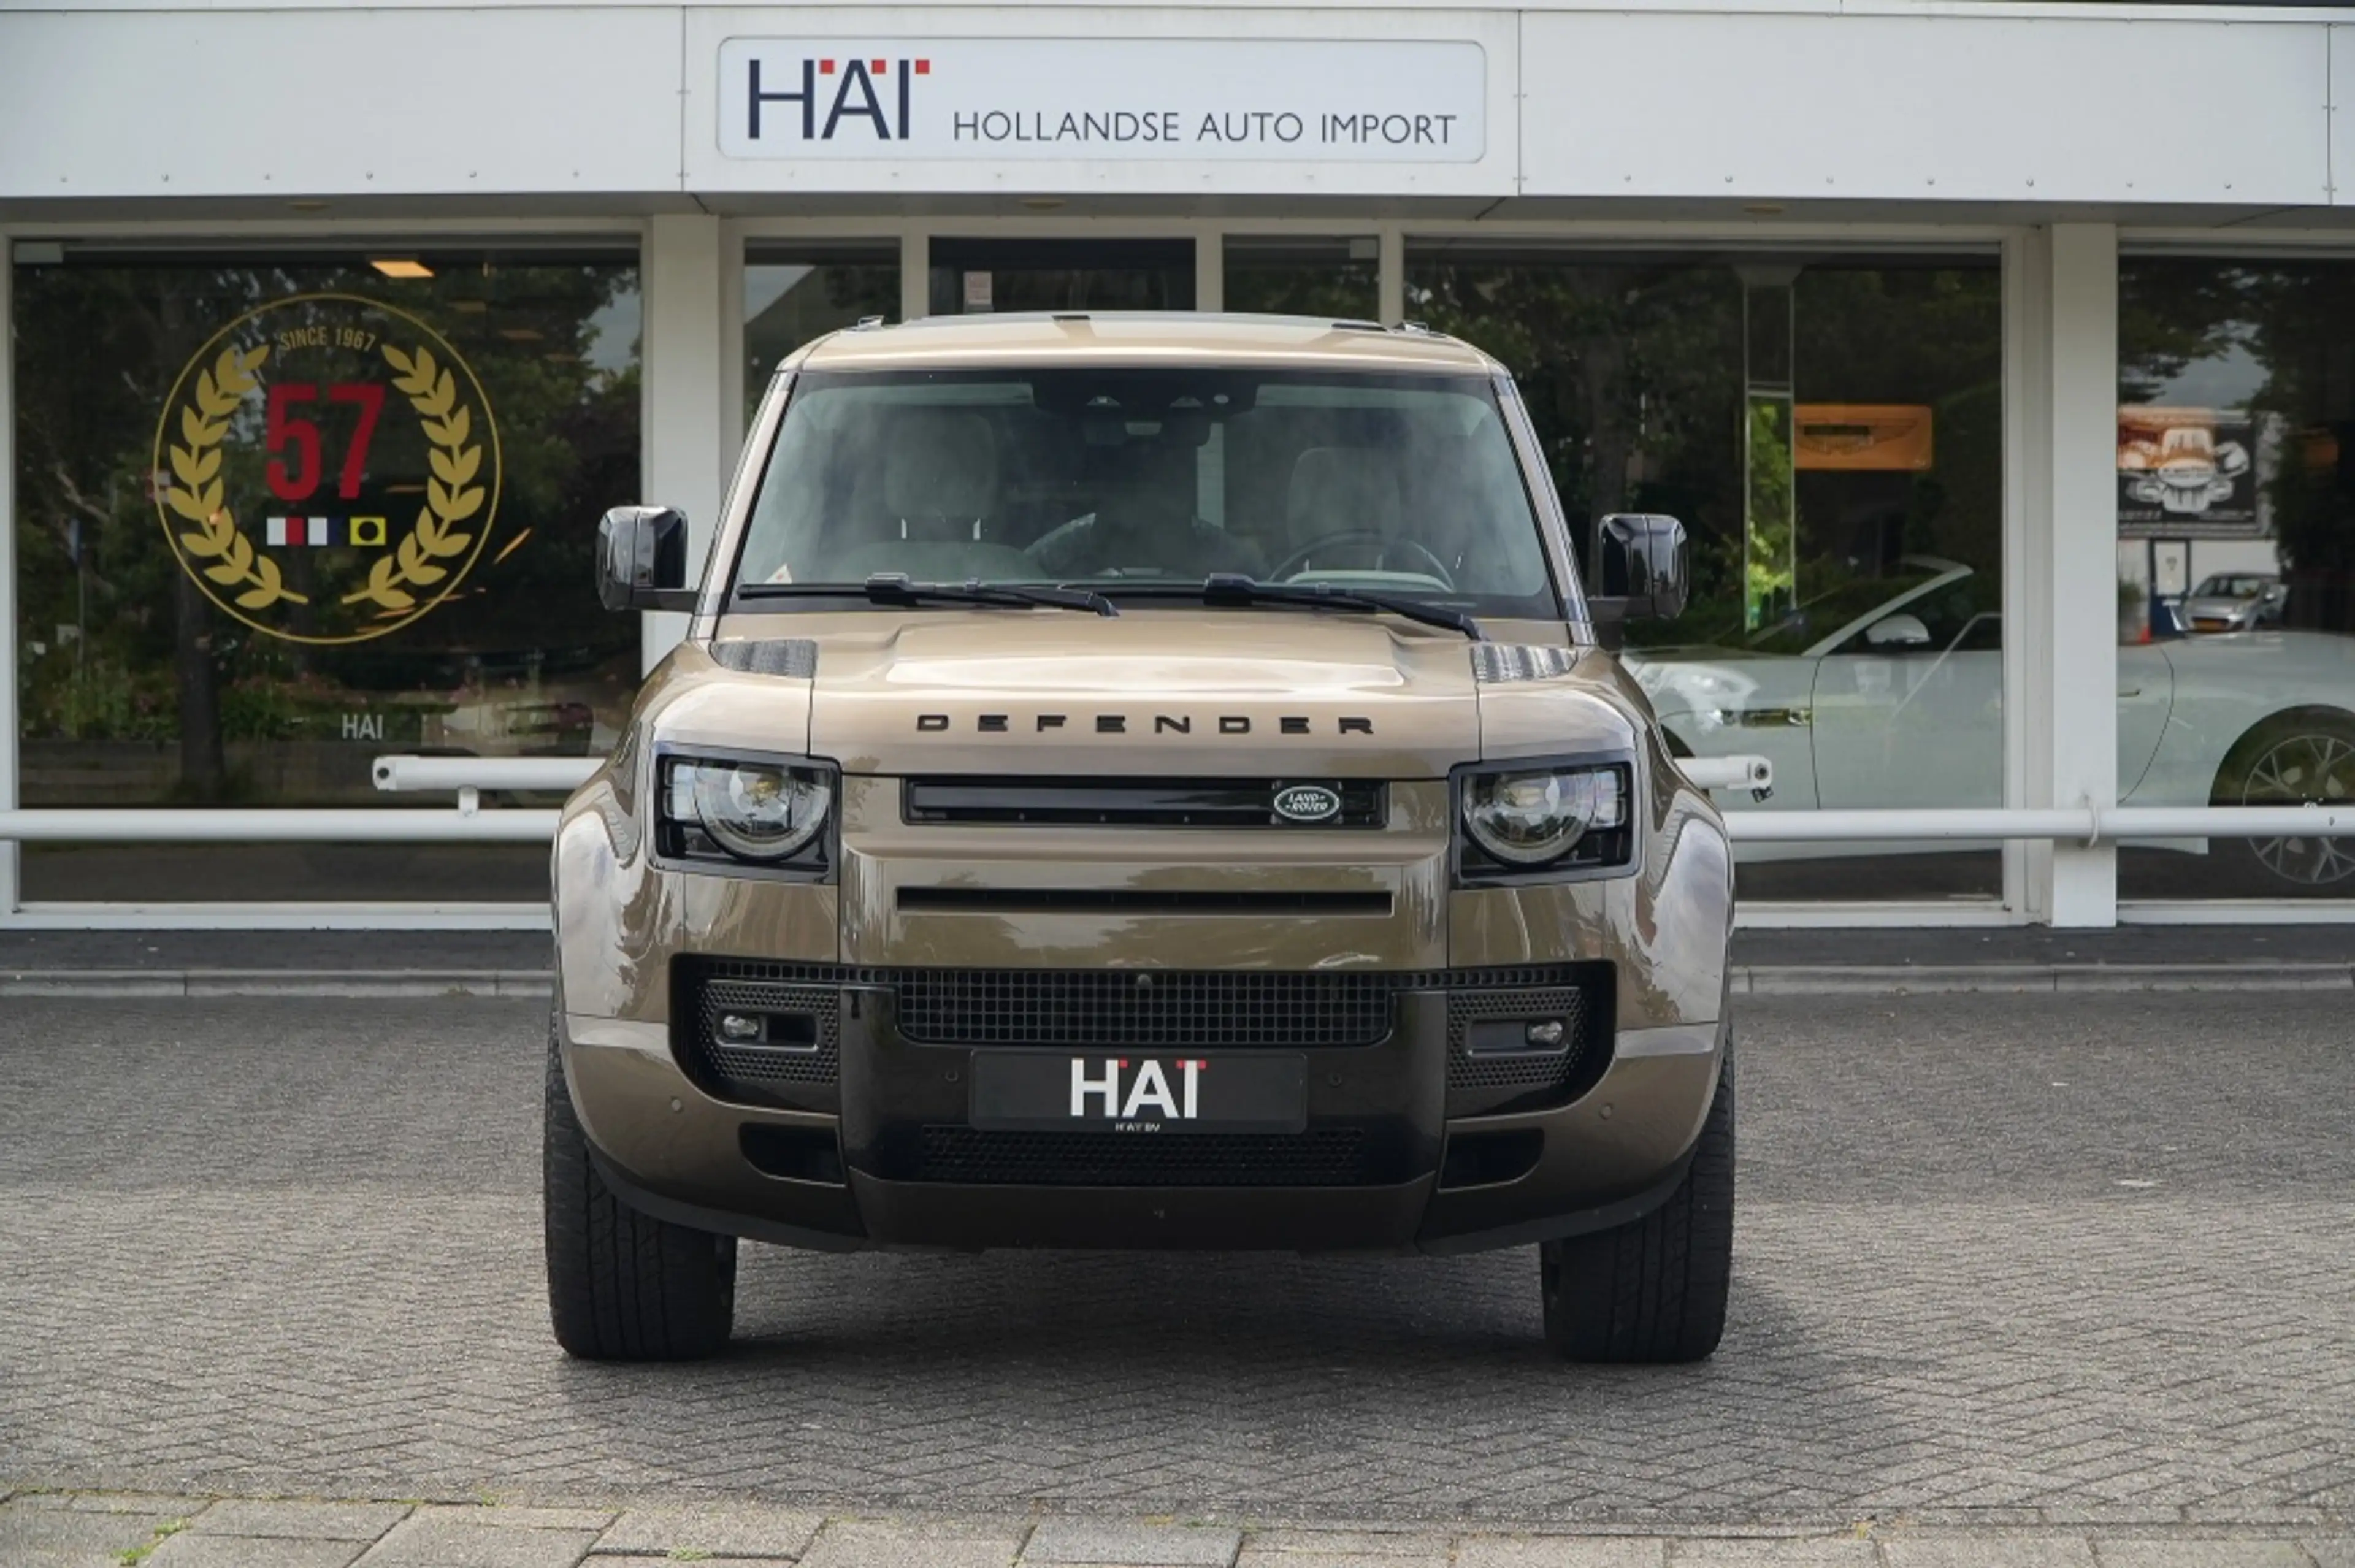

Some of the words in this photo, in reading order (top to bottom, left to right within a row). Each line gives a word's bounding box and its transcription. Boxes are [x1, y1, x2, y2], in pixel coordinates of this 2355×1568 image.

[953, 111, 1181, 141] HOLLANDSE
[1197, 112, 1304, 142] AUTO
[1321, 113, 1457, 144] IMPORT
[280, 326, 327, 351] SINCE
[335, 327, 377, 353] 1967
[266, 383, 385, 502] 57
[342, 713, 383, 740] HAI
[916, 714, 1374, 734] DEFENDER
